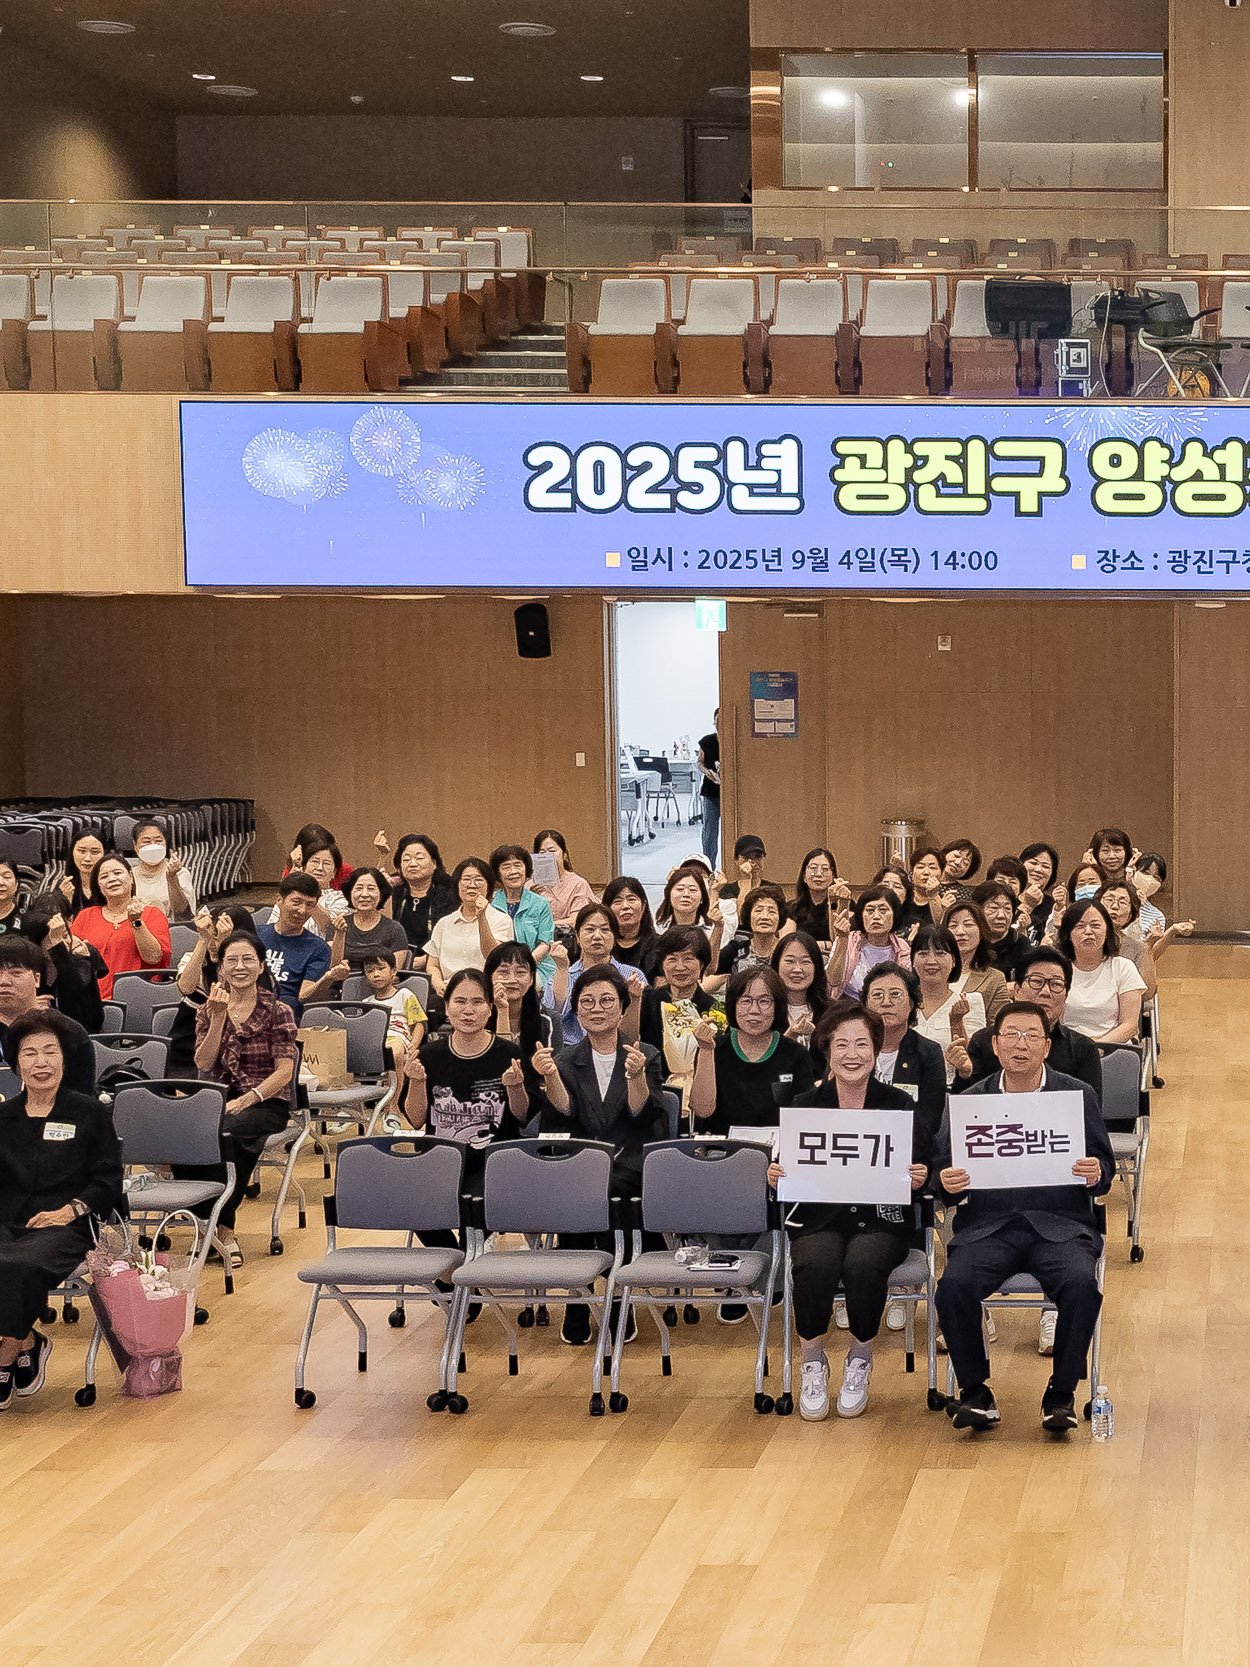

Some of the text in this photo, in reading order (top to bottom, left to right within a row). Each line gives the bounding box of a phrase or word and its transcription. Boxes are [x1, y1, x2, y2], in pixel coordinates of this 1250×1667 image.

[524, 436, 804, 513] 2025년
[829, 435, 1071, 518] 광진구
[627, 547, 673, 572] 일시
[698, 548, 782, 572] 2025년
[791, 548, 829, 572] 9월
[838, 548, 920, 574] 4일(목)
[930, 550, 997, 571] 14:00
[1096, 549, 1145, 574] 장소
[798, 1132, 894, 1167] 모두가
[965, 1122, 1070, 1158] 존중받는
